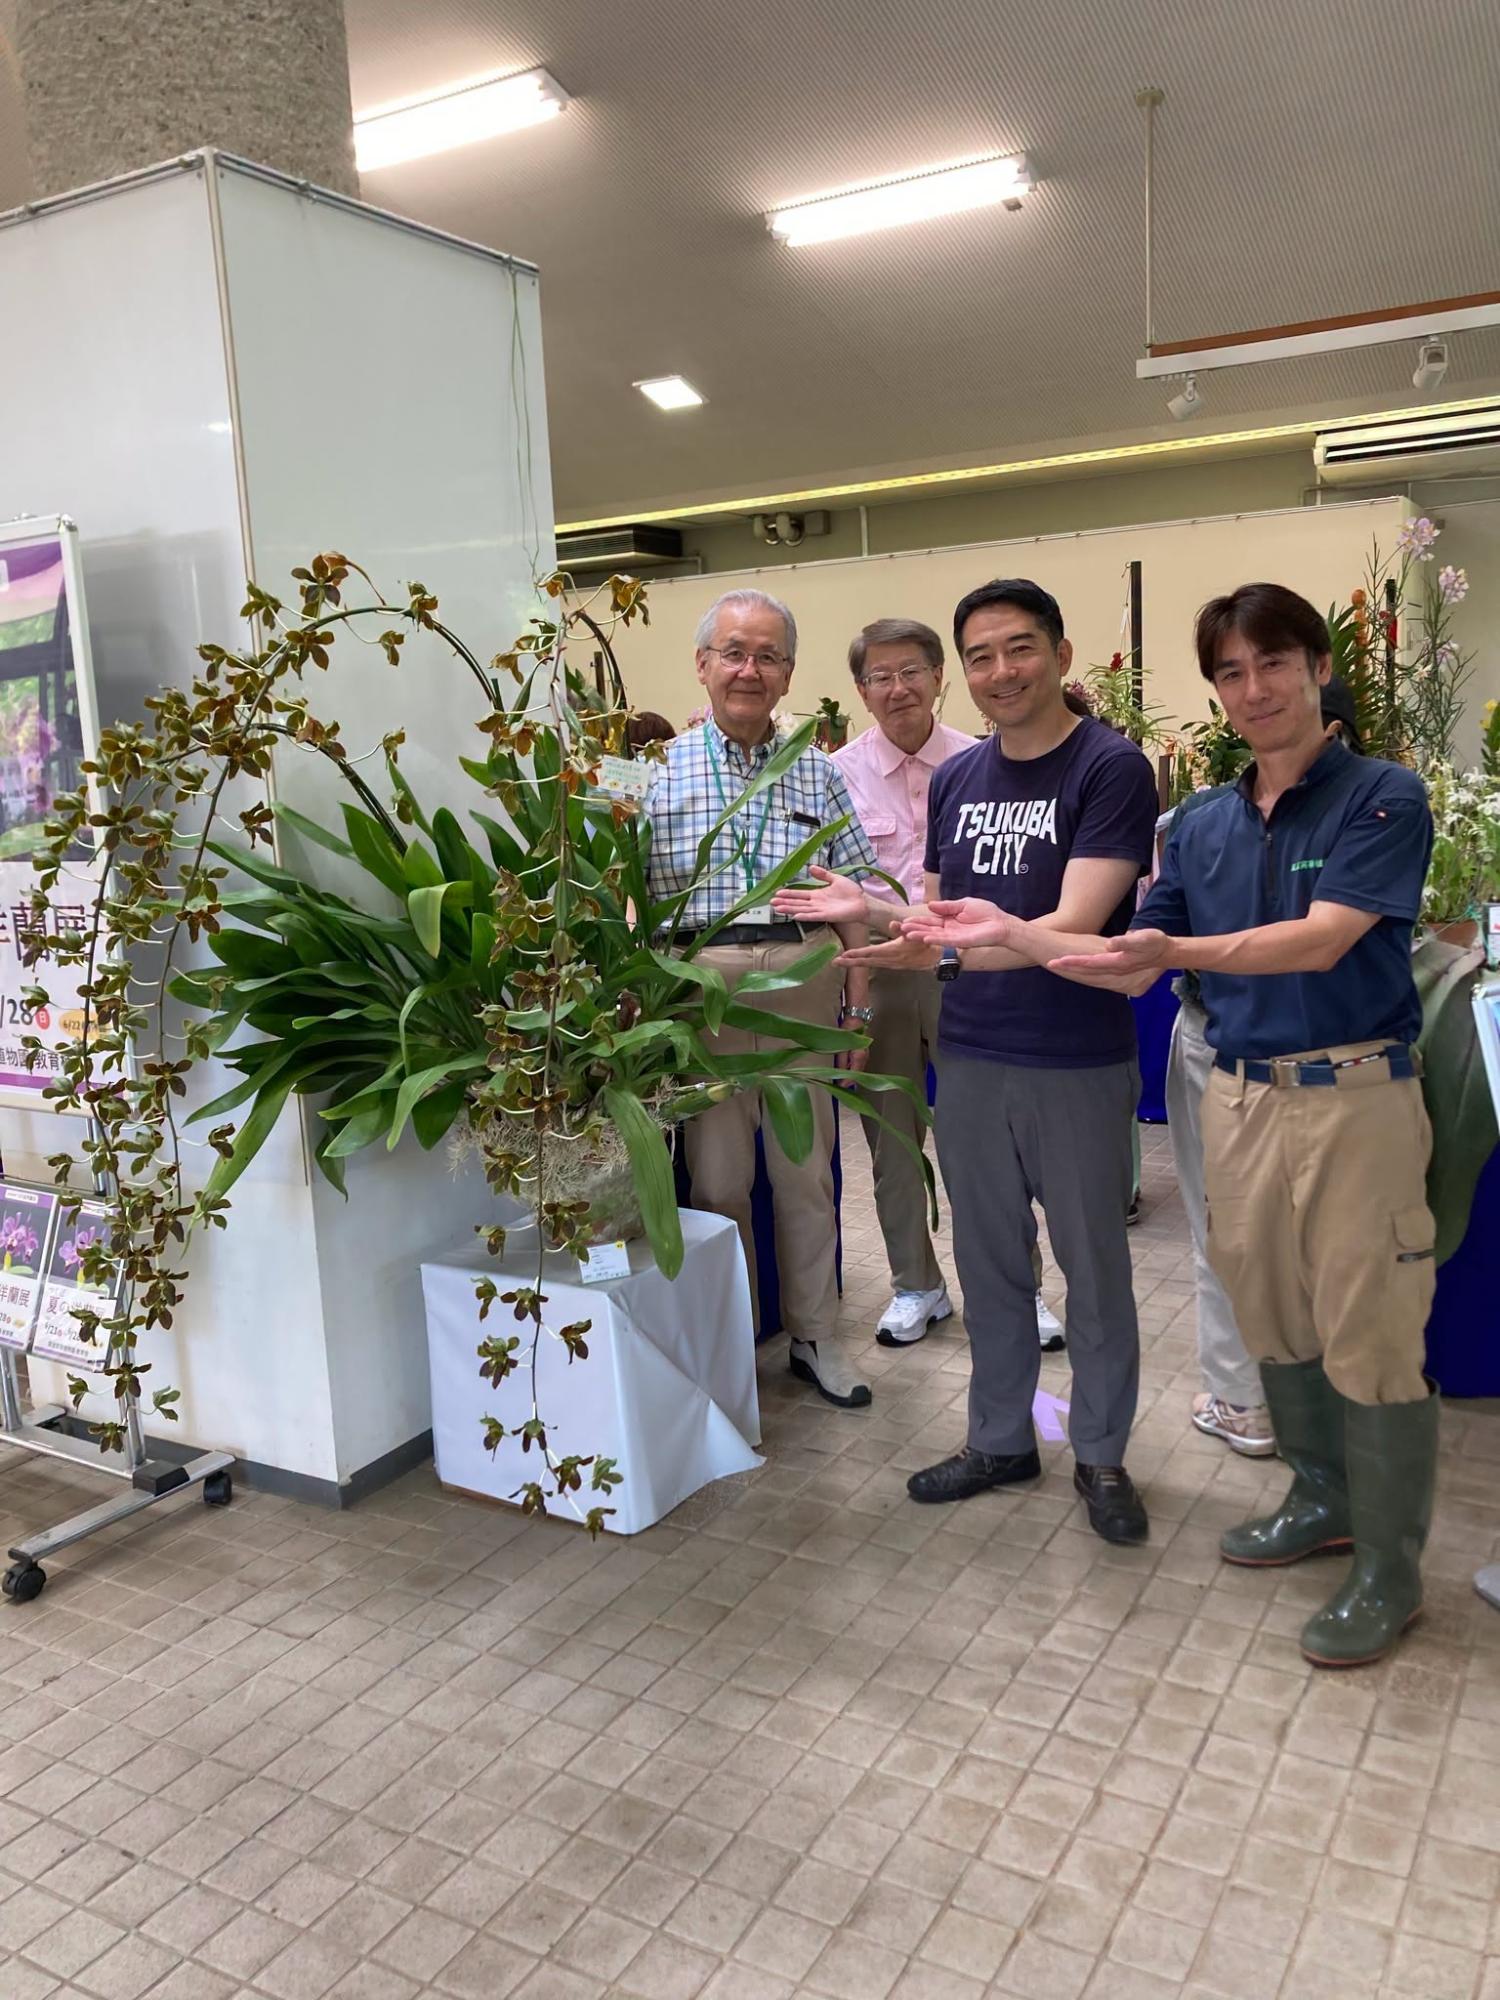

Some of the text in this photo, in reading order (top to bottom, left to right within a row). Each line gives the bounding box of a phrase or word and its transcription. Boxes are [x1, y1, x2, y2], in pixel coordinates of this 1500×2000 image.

[953, 798, 1057, 845] TSUKUBA
[972, 834, 1027, 875] CITY
[0, 901, 90, 961] 蘭展
